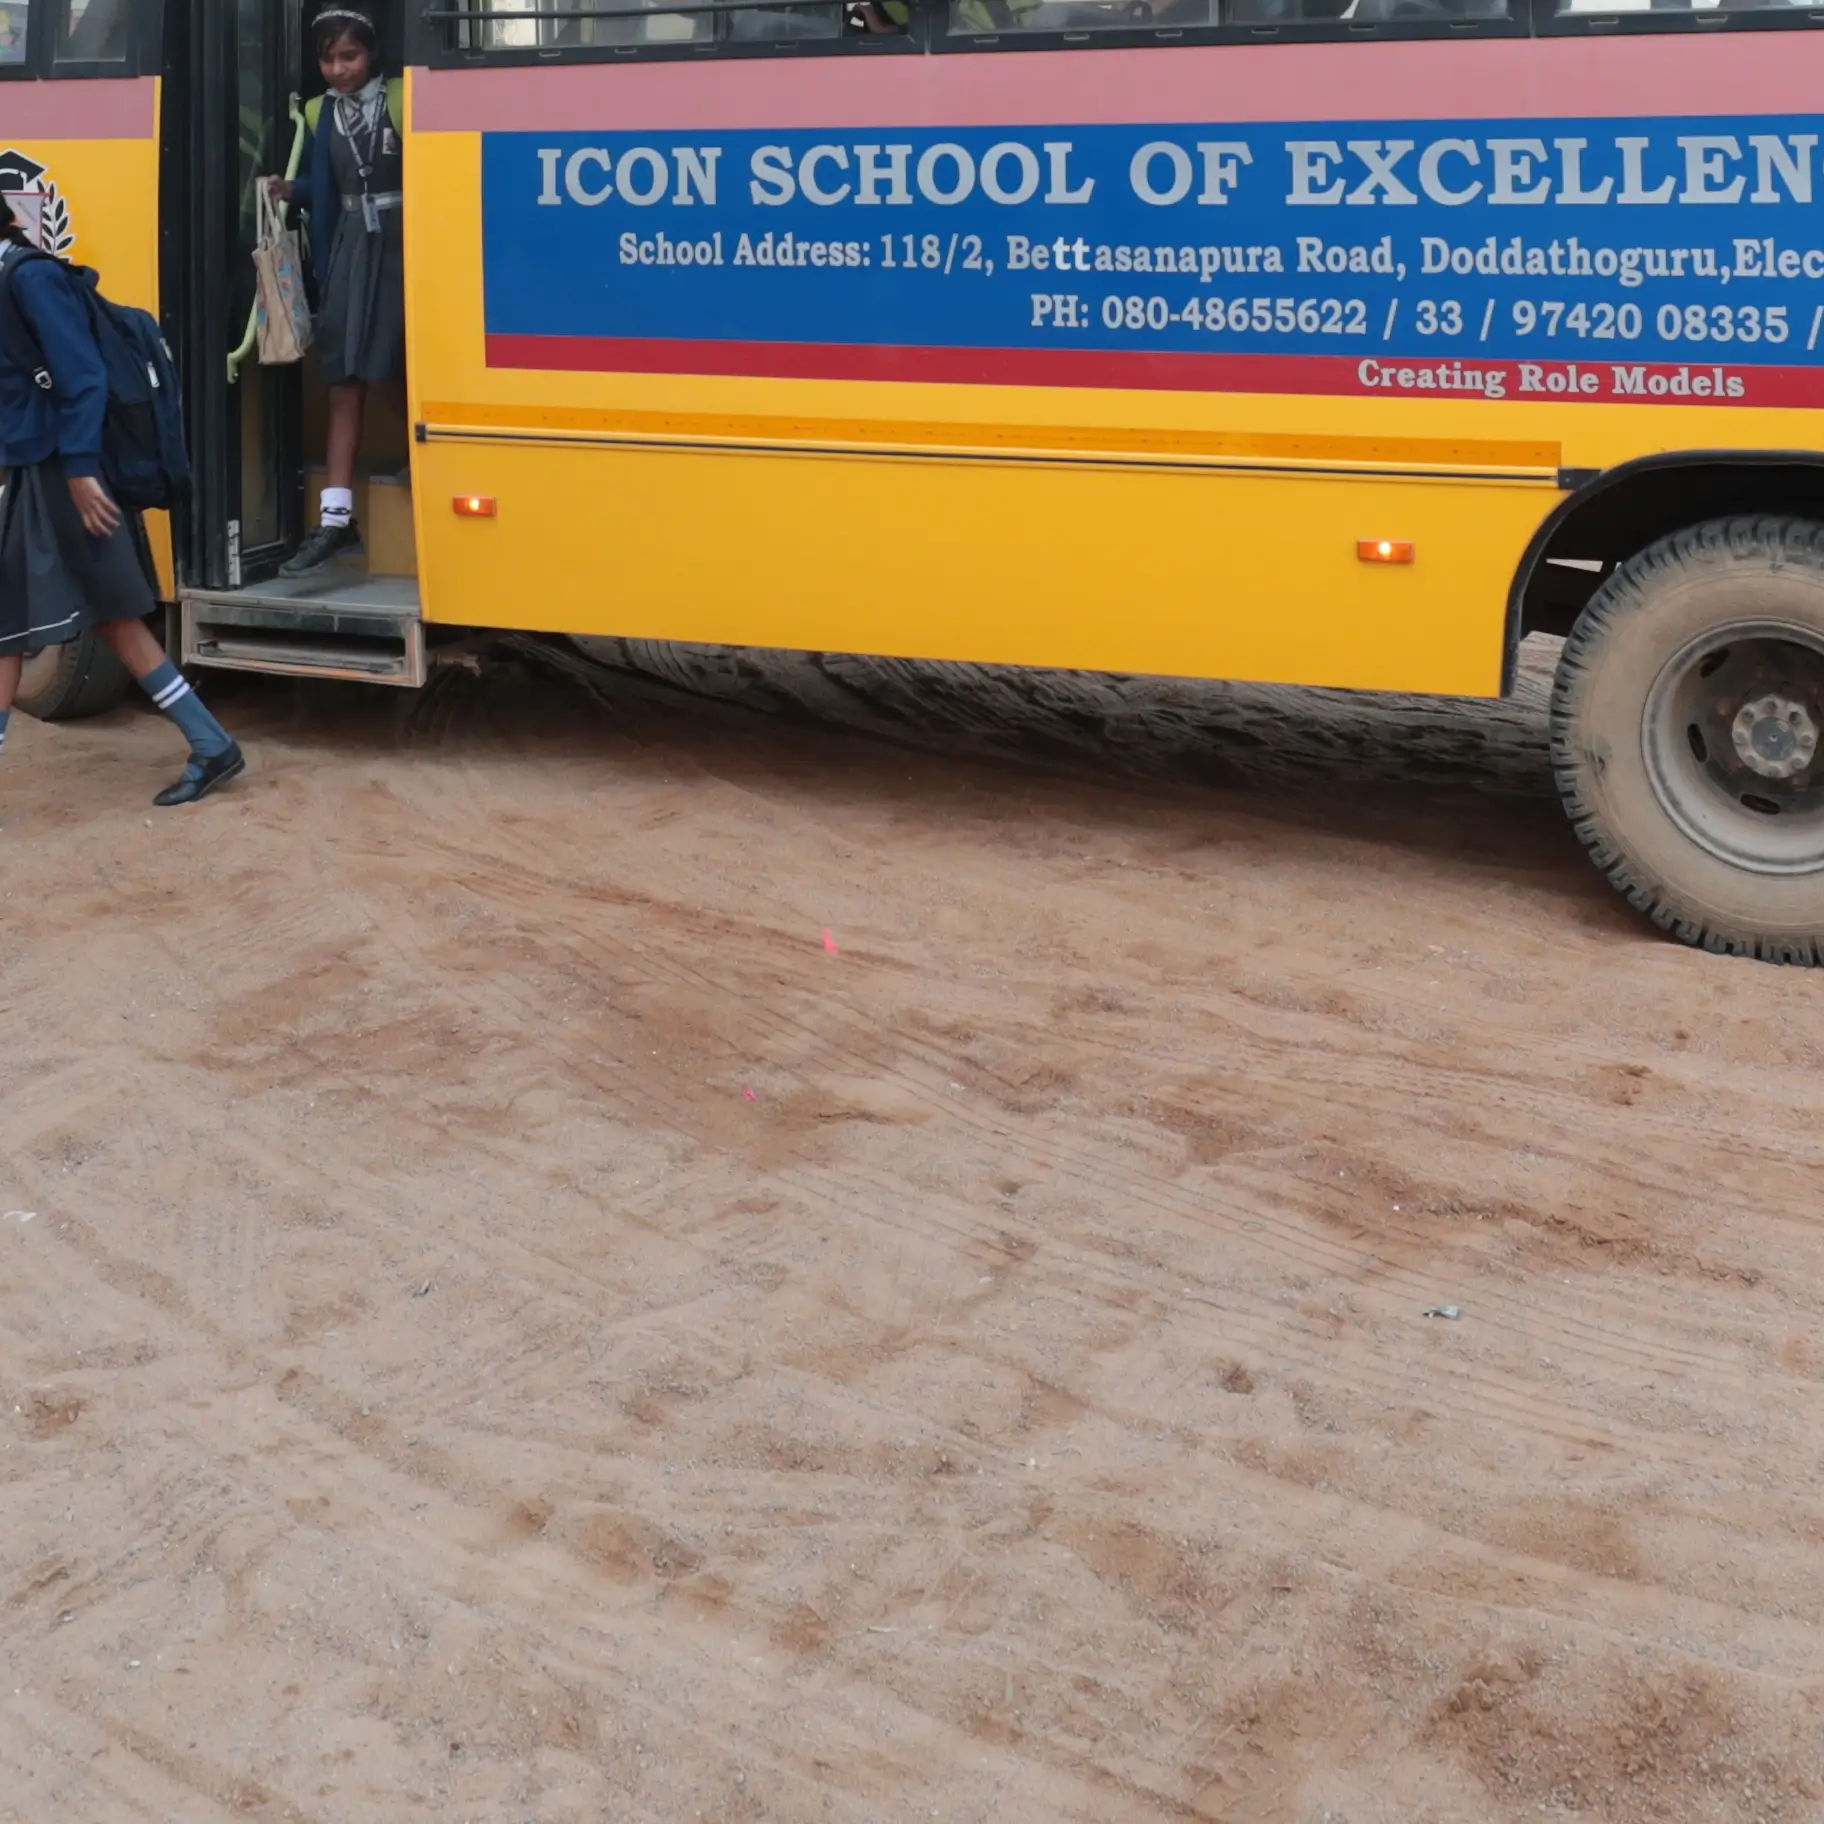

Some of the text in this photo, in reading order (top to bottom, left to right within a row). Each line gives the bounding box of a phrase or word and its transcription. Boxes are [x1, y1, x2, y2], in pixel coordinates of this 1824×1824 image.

[538, 147, 722, 206] ICON
[750, 142, 1094, 205] SCHOOL
[1130, 142, 1253, 205] OF
[620, 232, 723, 265] School
[733, 232, 870, 266] Address:
[882, 234, 993, 276] 118/2,
[1007, 236, 1284, 282] Bettasanapura
[1296, 236, 1405, 280] Road,
[1031, 294, 1088, 327] PH:
[1102, 296, 1366, 334] 080-48655622
[1384, 299, 1398, 340] /
[1416, 300, 1463, 335] 33
[1480, 299, 1494, 341] /
[1513, 300, 1642, 339] 97420
[1657, 304, 1788, 343] 08335
[1807, 306, 1824, 350] /
[1357, 359, 1745, 400] Creating Role Models
